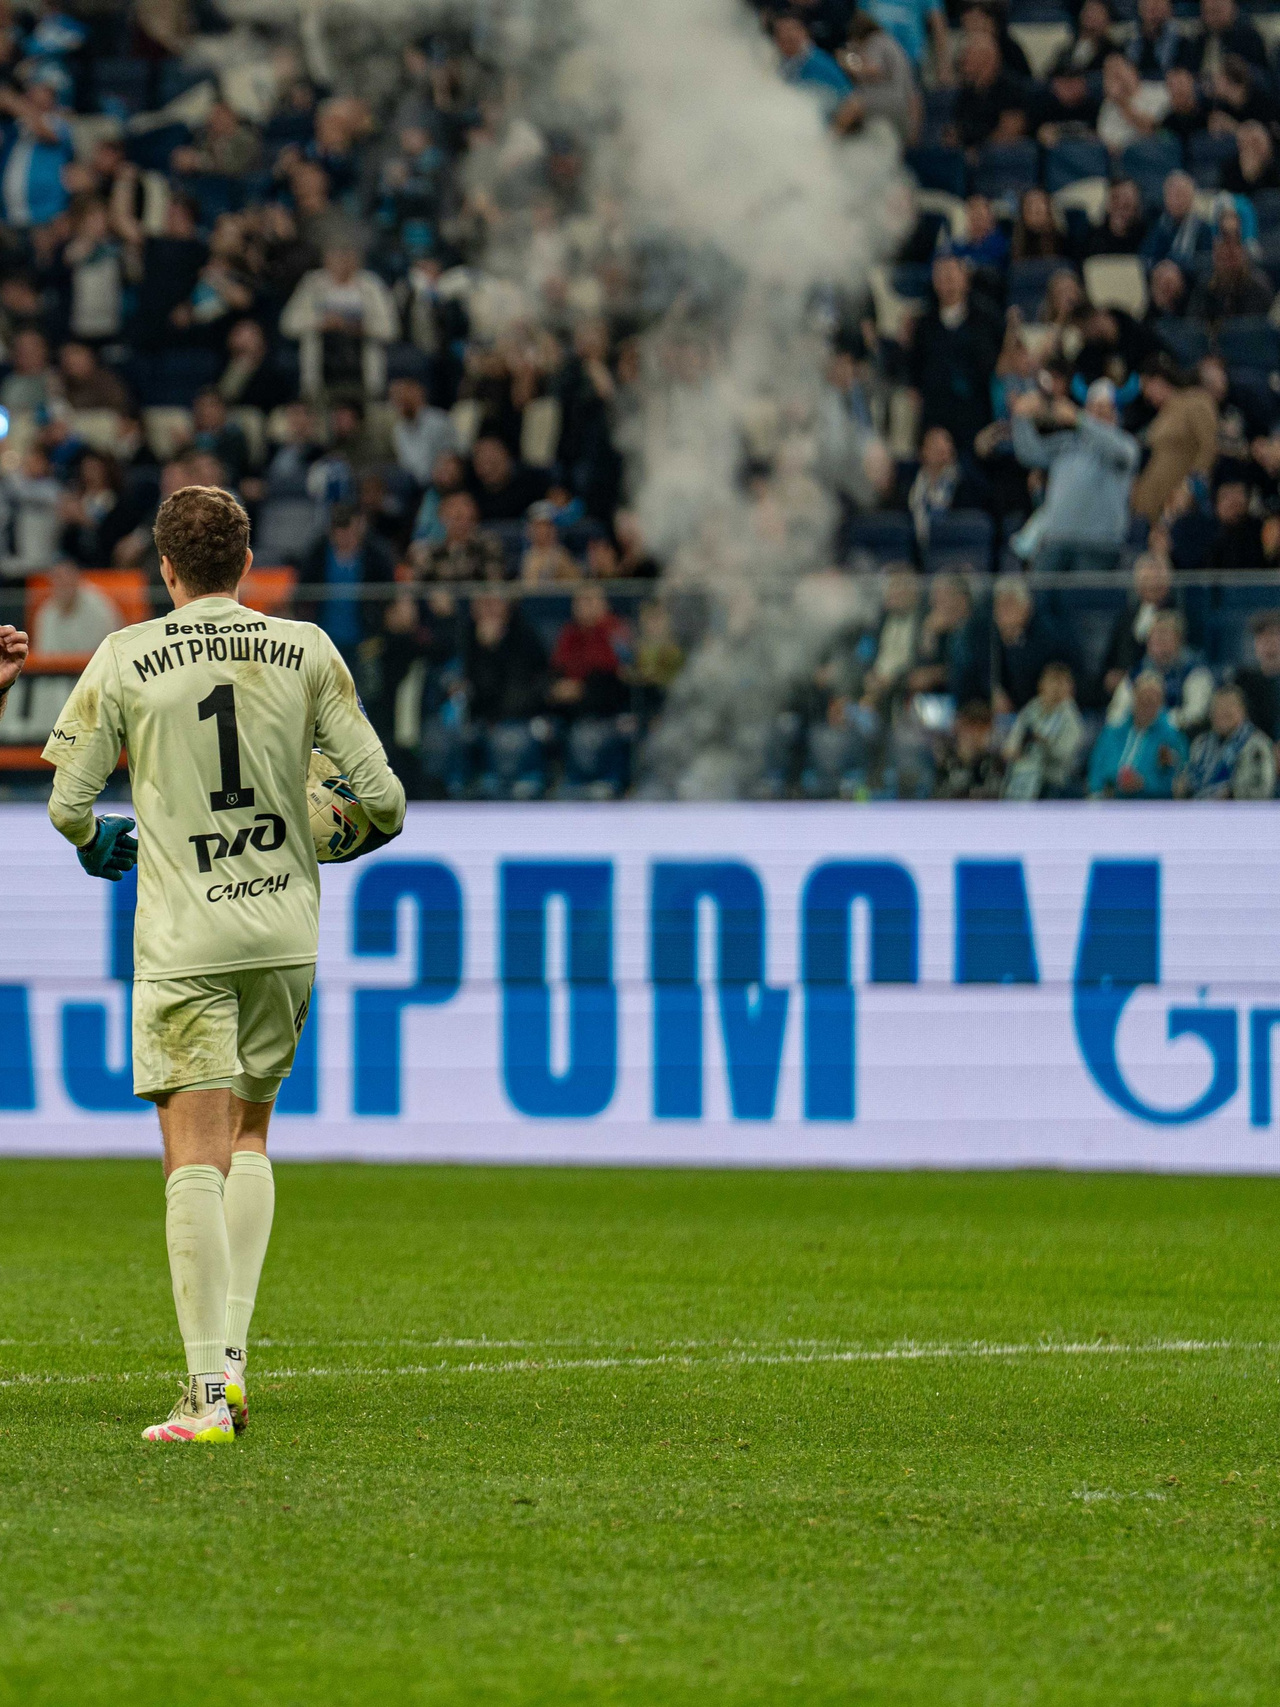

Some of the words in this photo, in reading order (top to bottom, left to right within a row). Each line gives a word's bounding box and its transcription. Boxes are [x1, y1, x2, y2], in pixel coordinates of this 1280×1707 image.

[165, 621, 267, 636] BetBoom
[132, 636, 304, 683] МИТРЮШКИН
[197, 684, 255, 812] 1
[206, 873, 290, 903] САПСАН
